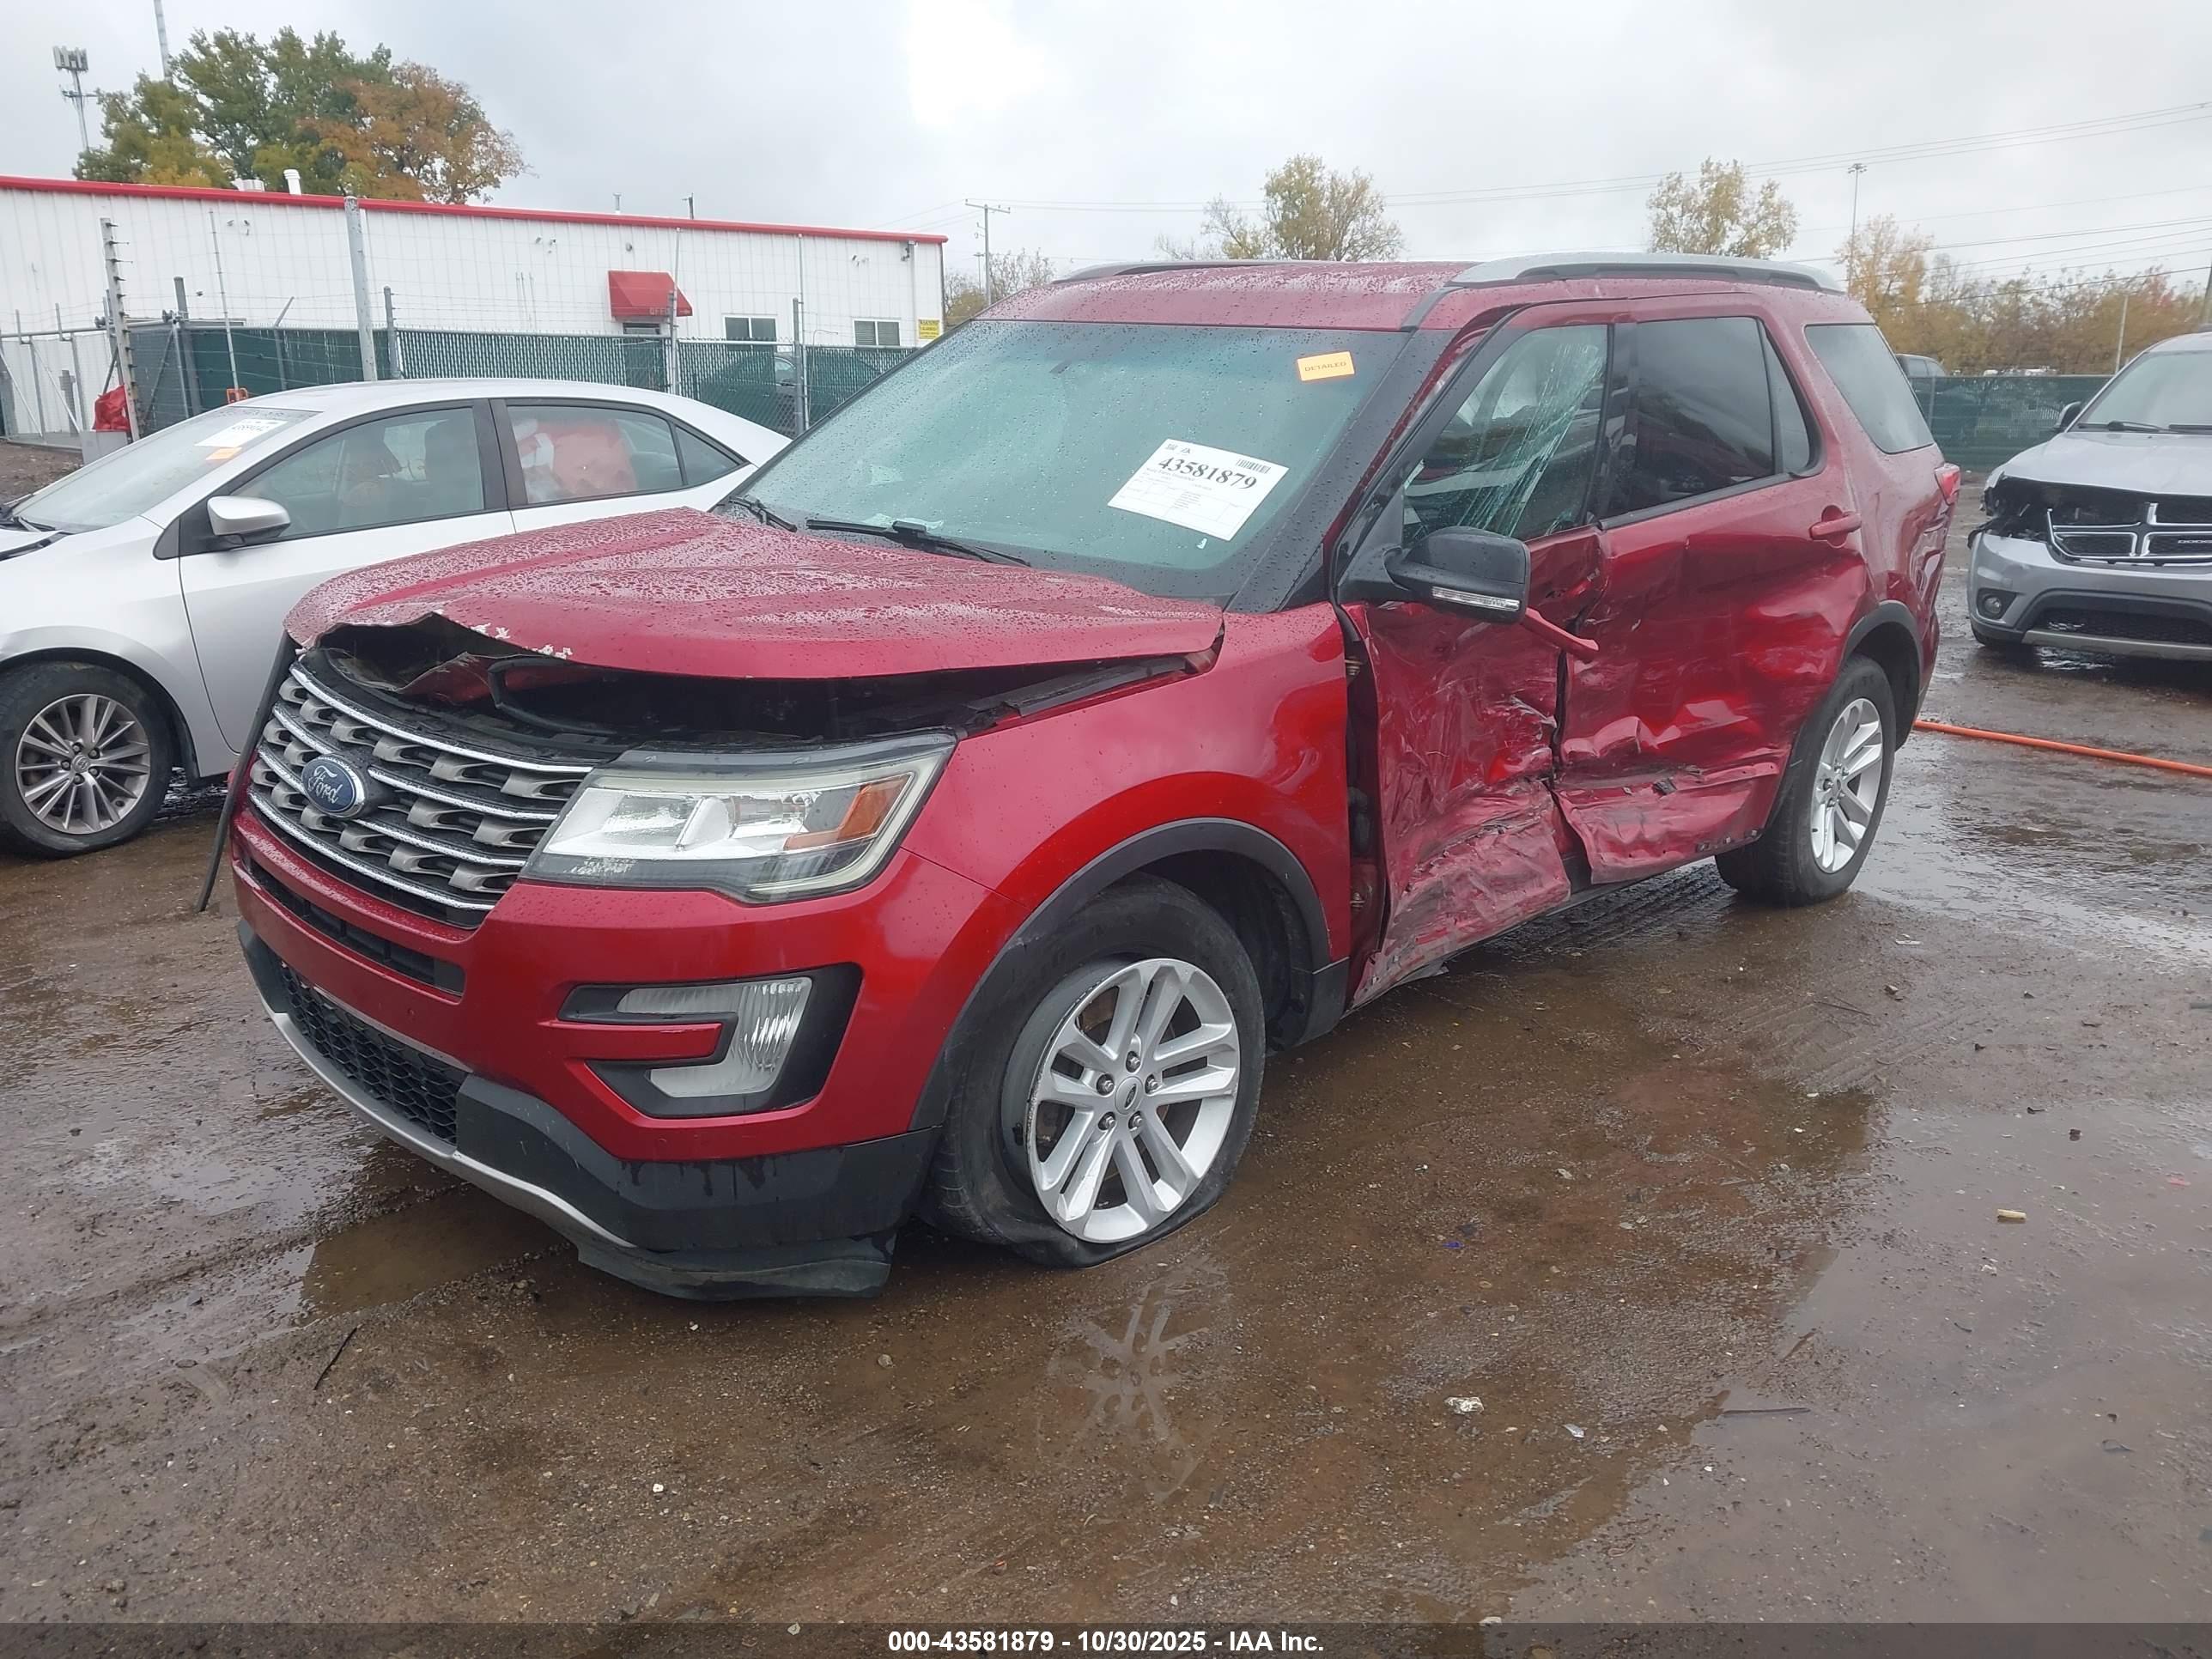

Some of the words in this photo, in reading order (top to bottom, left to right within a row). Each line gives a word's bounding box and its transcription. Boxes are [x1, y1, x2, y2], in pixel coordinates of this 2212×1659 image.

[1304, 362, 1347, 372] DETAILED
[1158, 456, 1257, 489] 43581879
[307, 765, 343, 804] Ford
